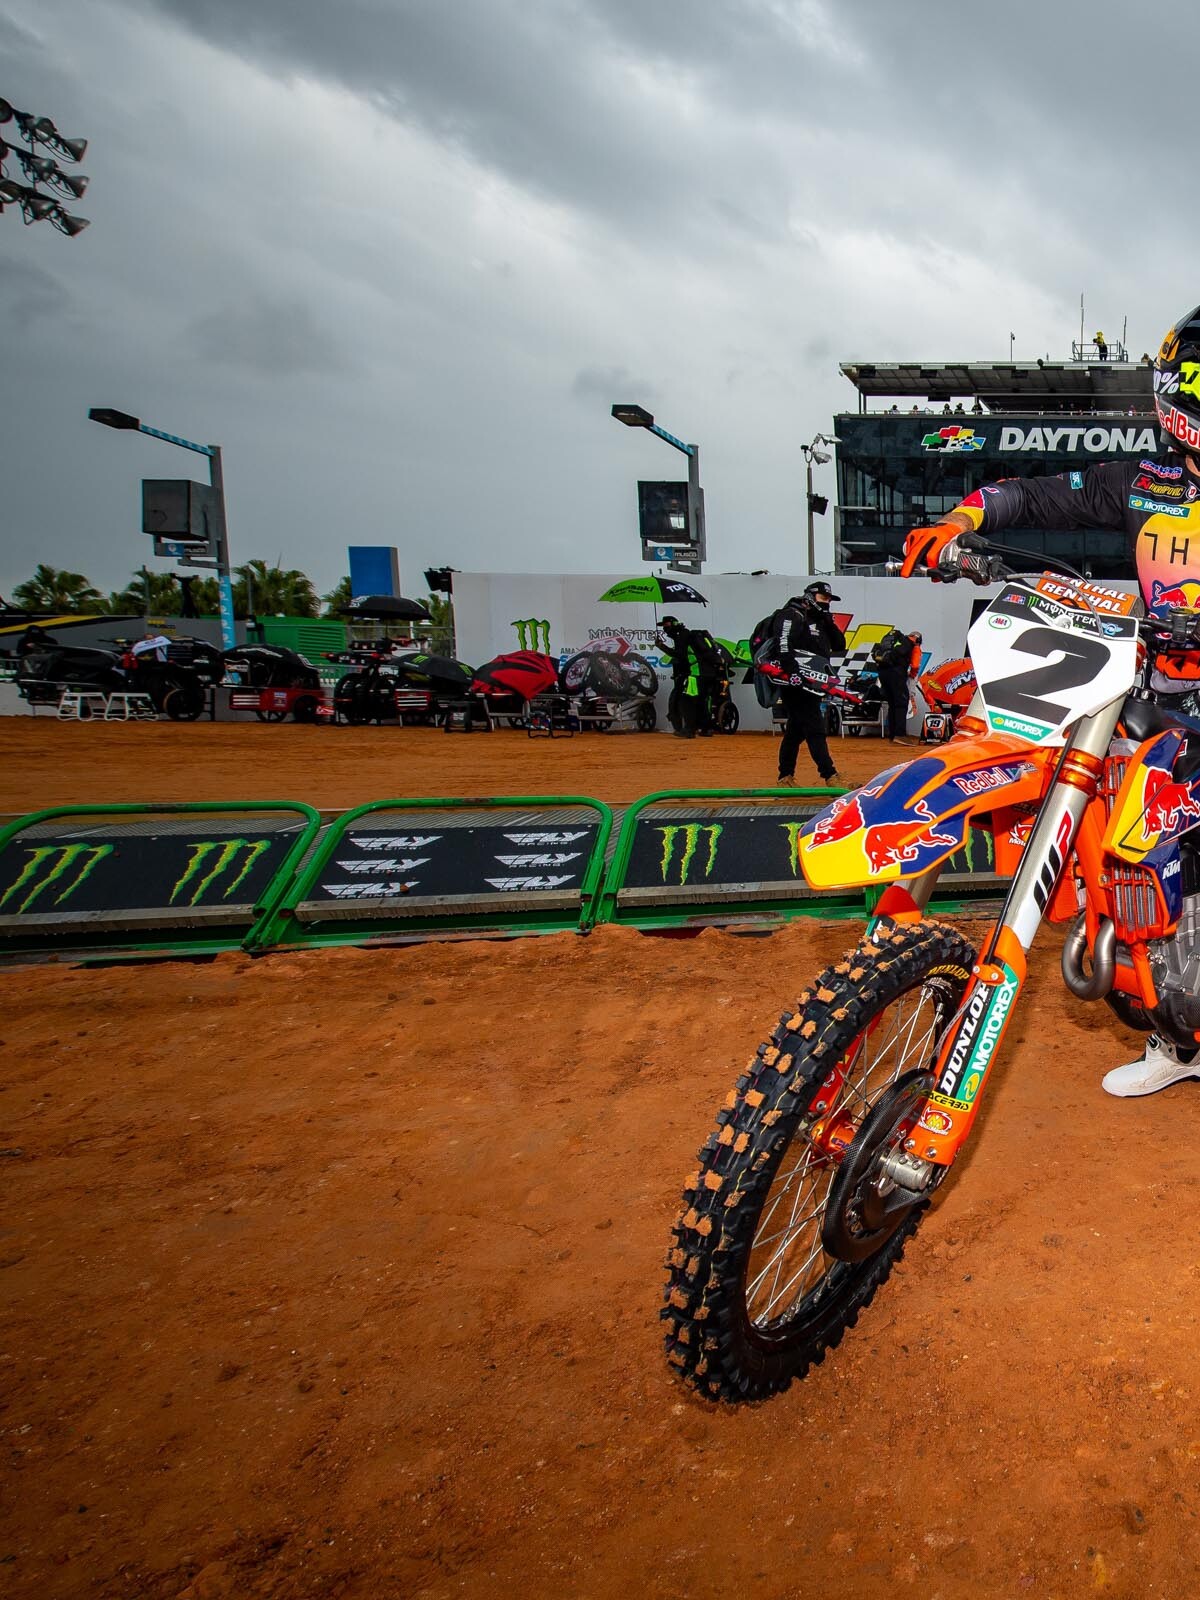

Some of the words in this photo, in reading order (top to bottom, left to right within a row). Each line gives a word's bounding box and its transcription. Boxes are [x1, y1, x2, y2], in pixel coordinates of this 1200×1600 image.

[999, 427, 1157, 452] DAYTONA
[1144, 501, 1184, 516] MOTOREX
[981, 627, 1111, 725] 2
[929, 719, 941, 728] 19
[1003, 718, 1044, 737] MOTOREX
[349, 836, 443, 848] FLY
[503, 832, 589, 843] FLY
[336, 858, 432, 871] FLY
[494, 853, 583, 865] FLY
[1162, 859, 1180, 880] KTM
[484, 875, 576, 889] FLY
[926, 964, 970, 980] DUNLOP
[972, 974, 1018, 1072] MOTOREX
[940, 982, 990, 1097] DUNLOP
